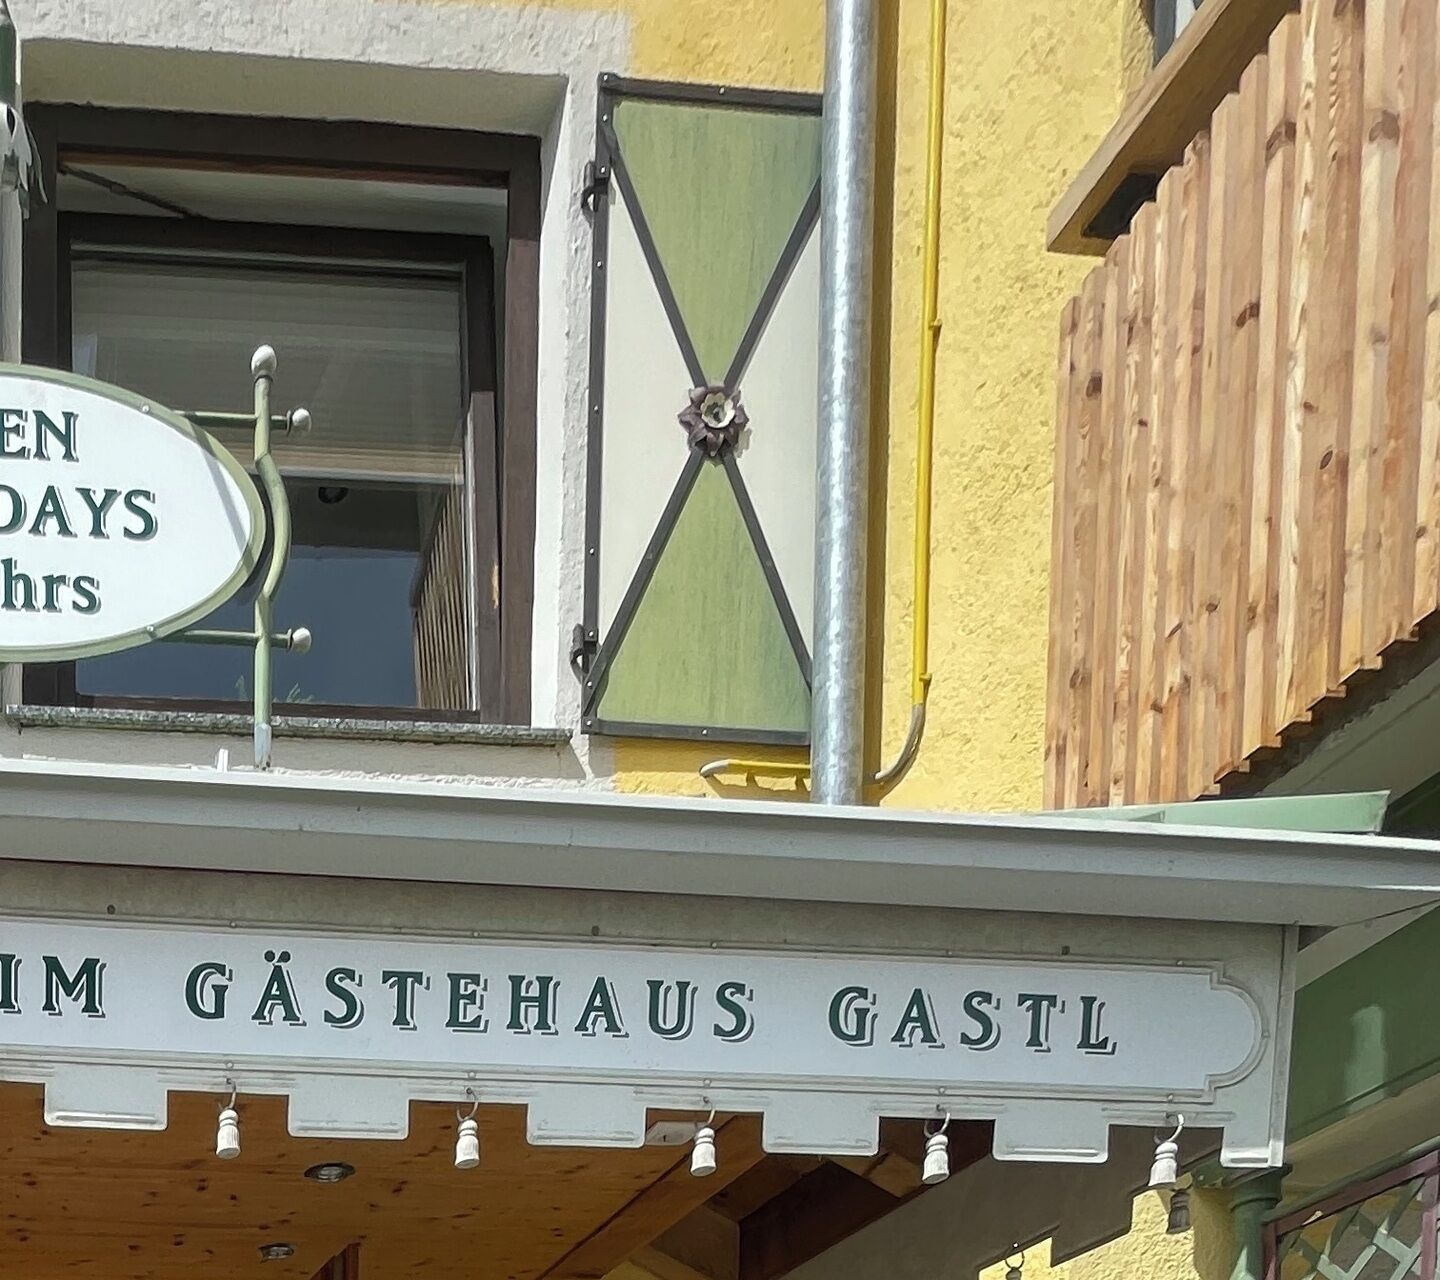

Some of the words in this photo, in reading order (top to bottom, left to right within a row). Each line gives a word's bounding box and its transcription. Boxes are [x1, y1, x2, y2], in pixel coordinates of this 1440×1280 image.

[0, 556, 100, 614] hrs
[186, 950, 758, 1043] GÄSTEHAUS
[828, 985, 1118, 1054] GASTL
